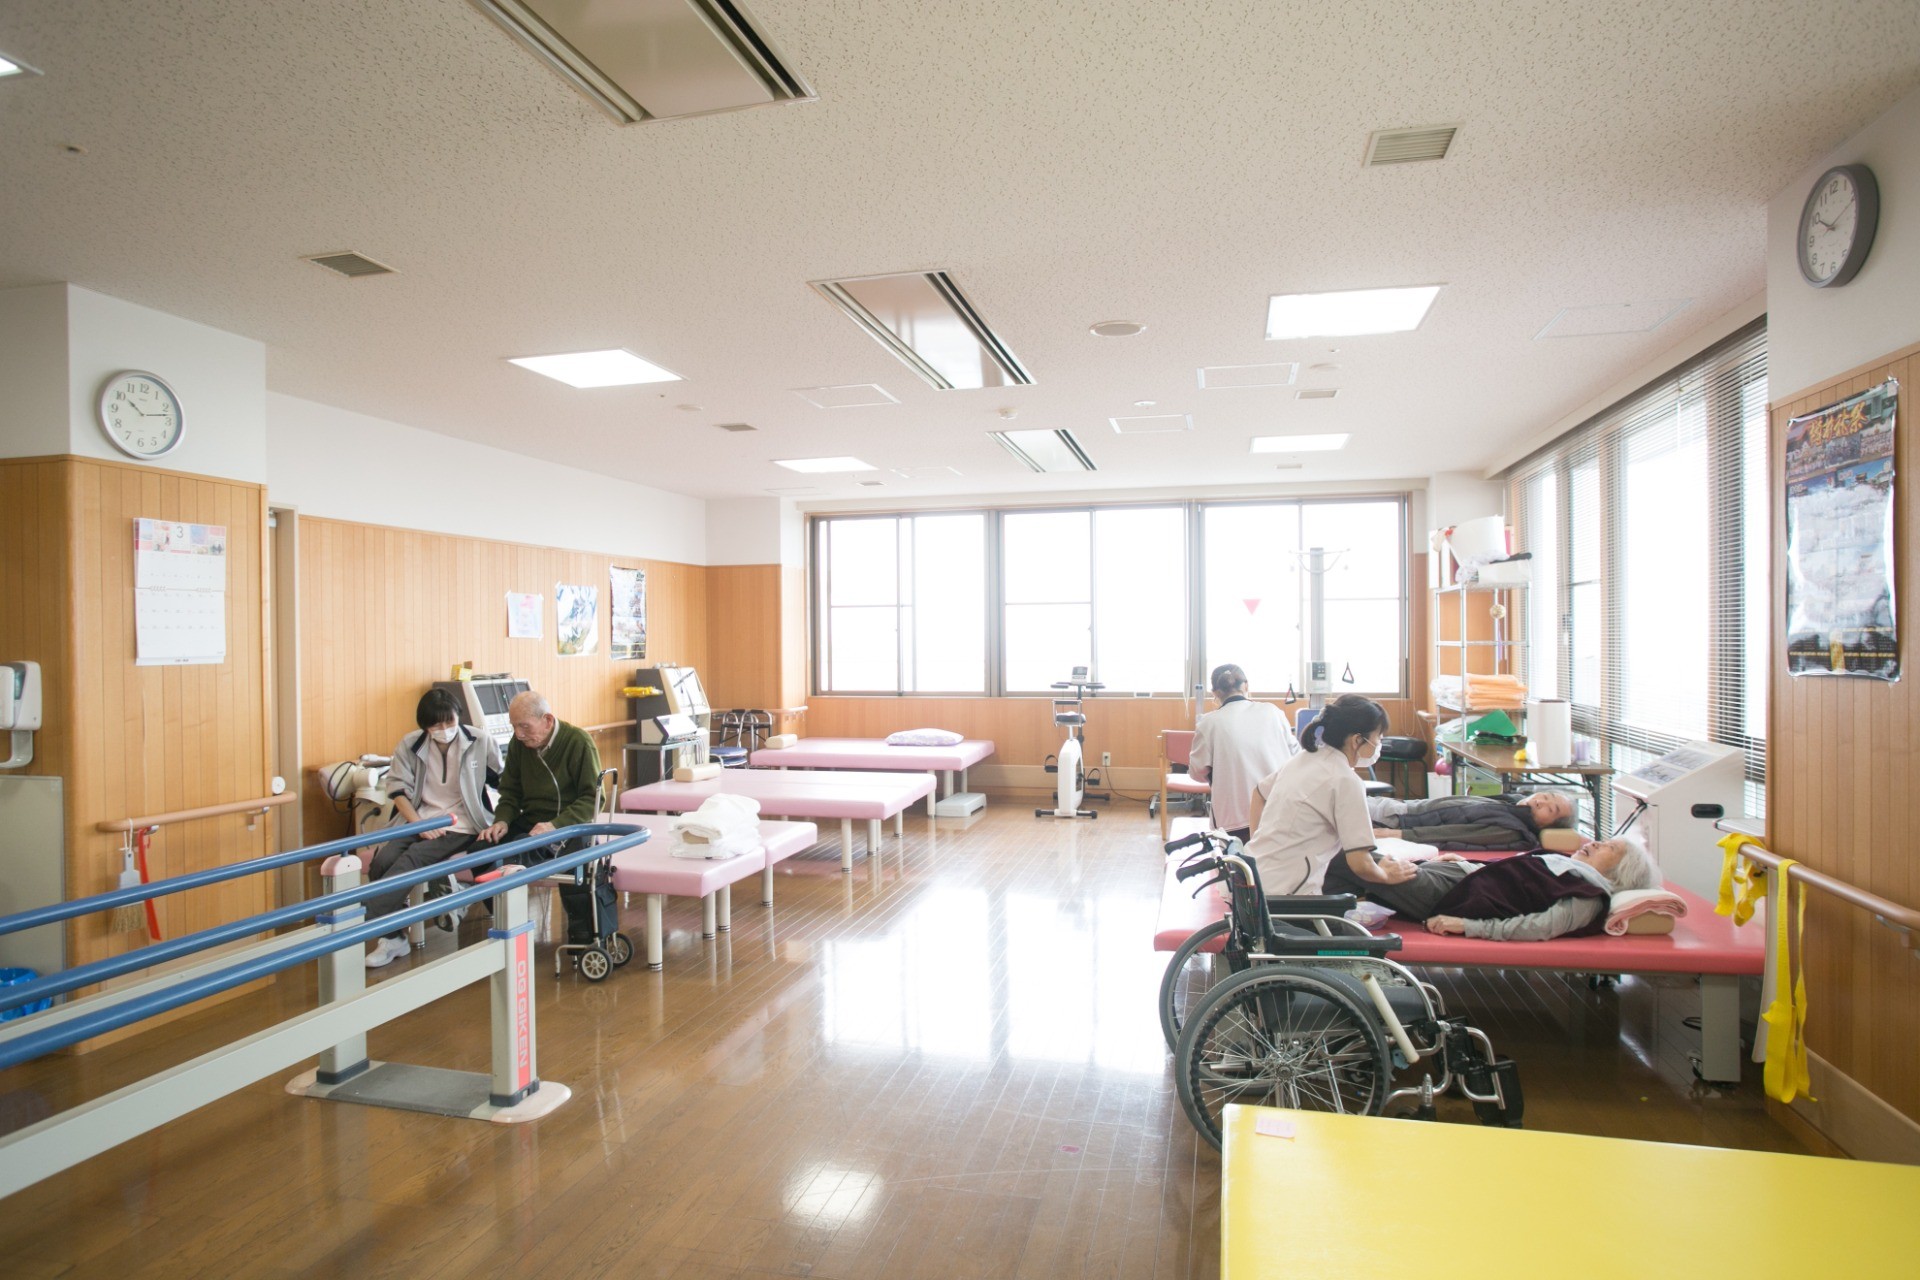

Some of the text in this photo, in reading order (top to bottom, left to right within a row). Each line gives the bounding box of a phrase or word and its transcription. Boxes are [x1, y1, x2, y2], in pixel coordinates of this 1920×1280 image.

[1829, 180, 1839, 196] 12
[1820, 193, 1827, 207] 11
[1812, 212, 1821, 227] 10
[1809, 235, 1815, 248] 9
[1812, 253, 1818, 266] 8
[1819, 262, 1825, 275] 7
[127, 383, 135, 394] 11
[139, 383, 150, 394] 12
[116, 390, 126, 401] 10
[155, 391, 159, 400] 1
[111, 403, 119, 413] 9
[162, 403, 169, 412] 2
[114, 418, 122, 428] 8
[165, 417, 172, 427] 3
[125, 431, 132, 440] 7
[137, 438, 144, 447] 6
[150, 437, 157, 446] 5
[177, 526, 184, 538] 3
[517, 960, 528, 1068] OG GIKEN
